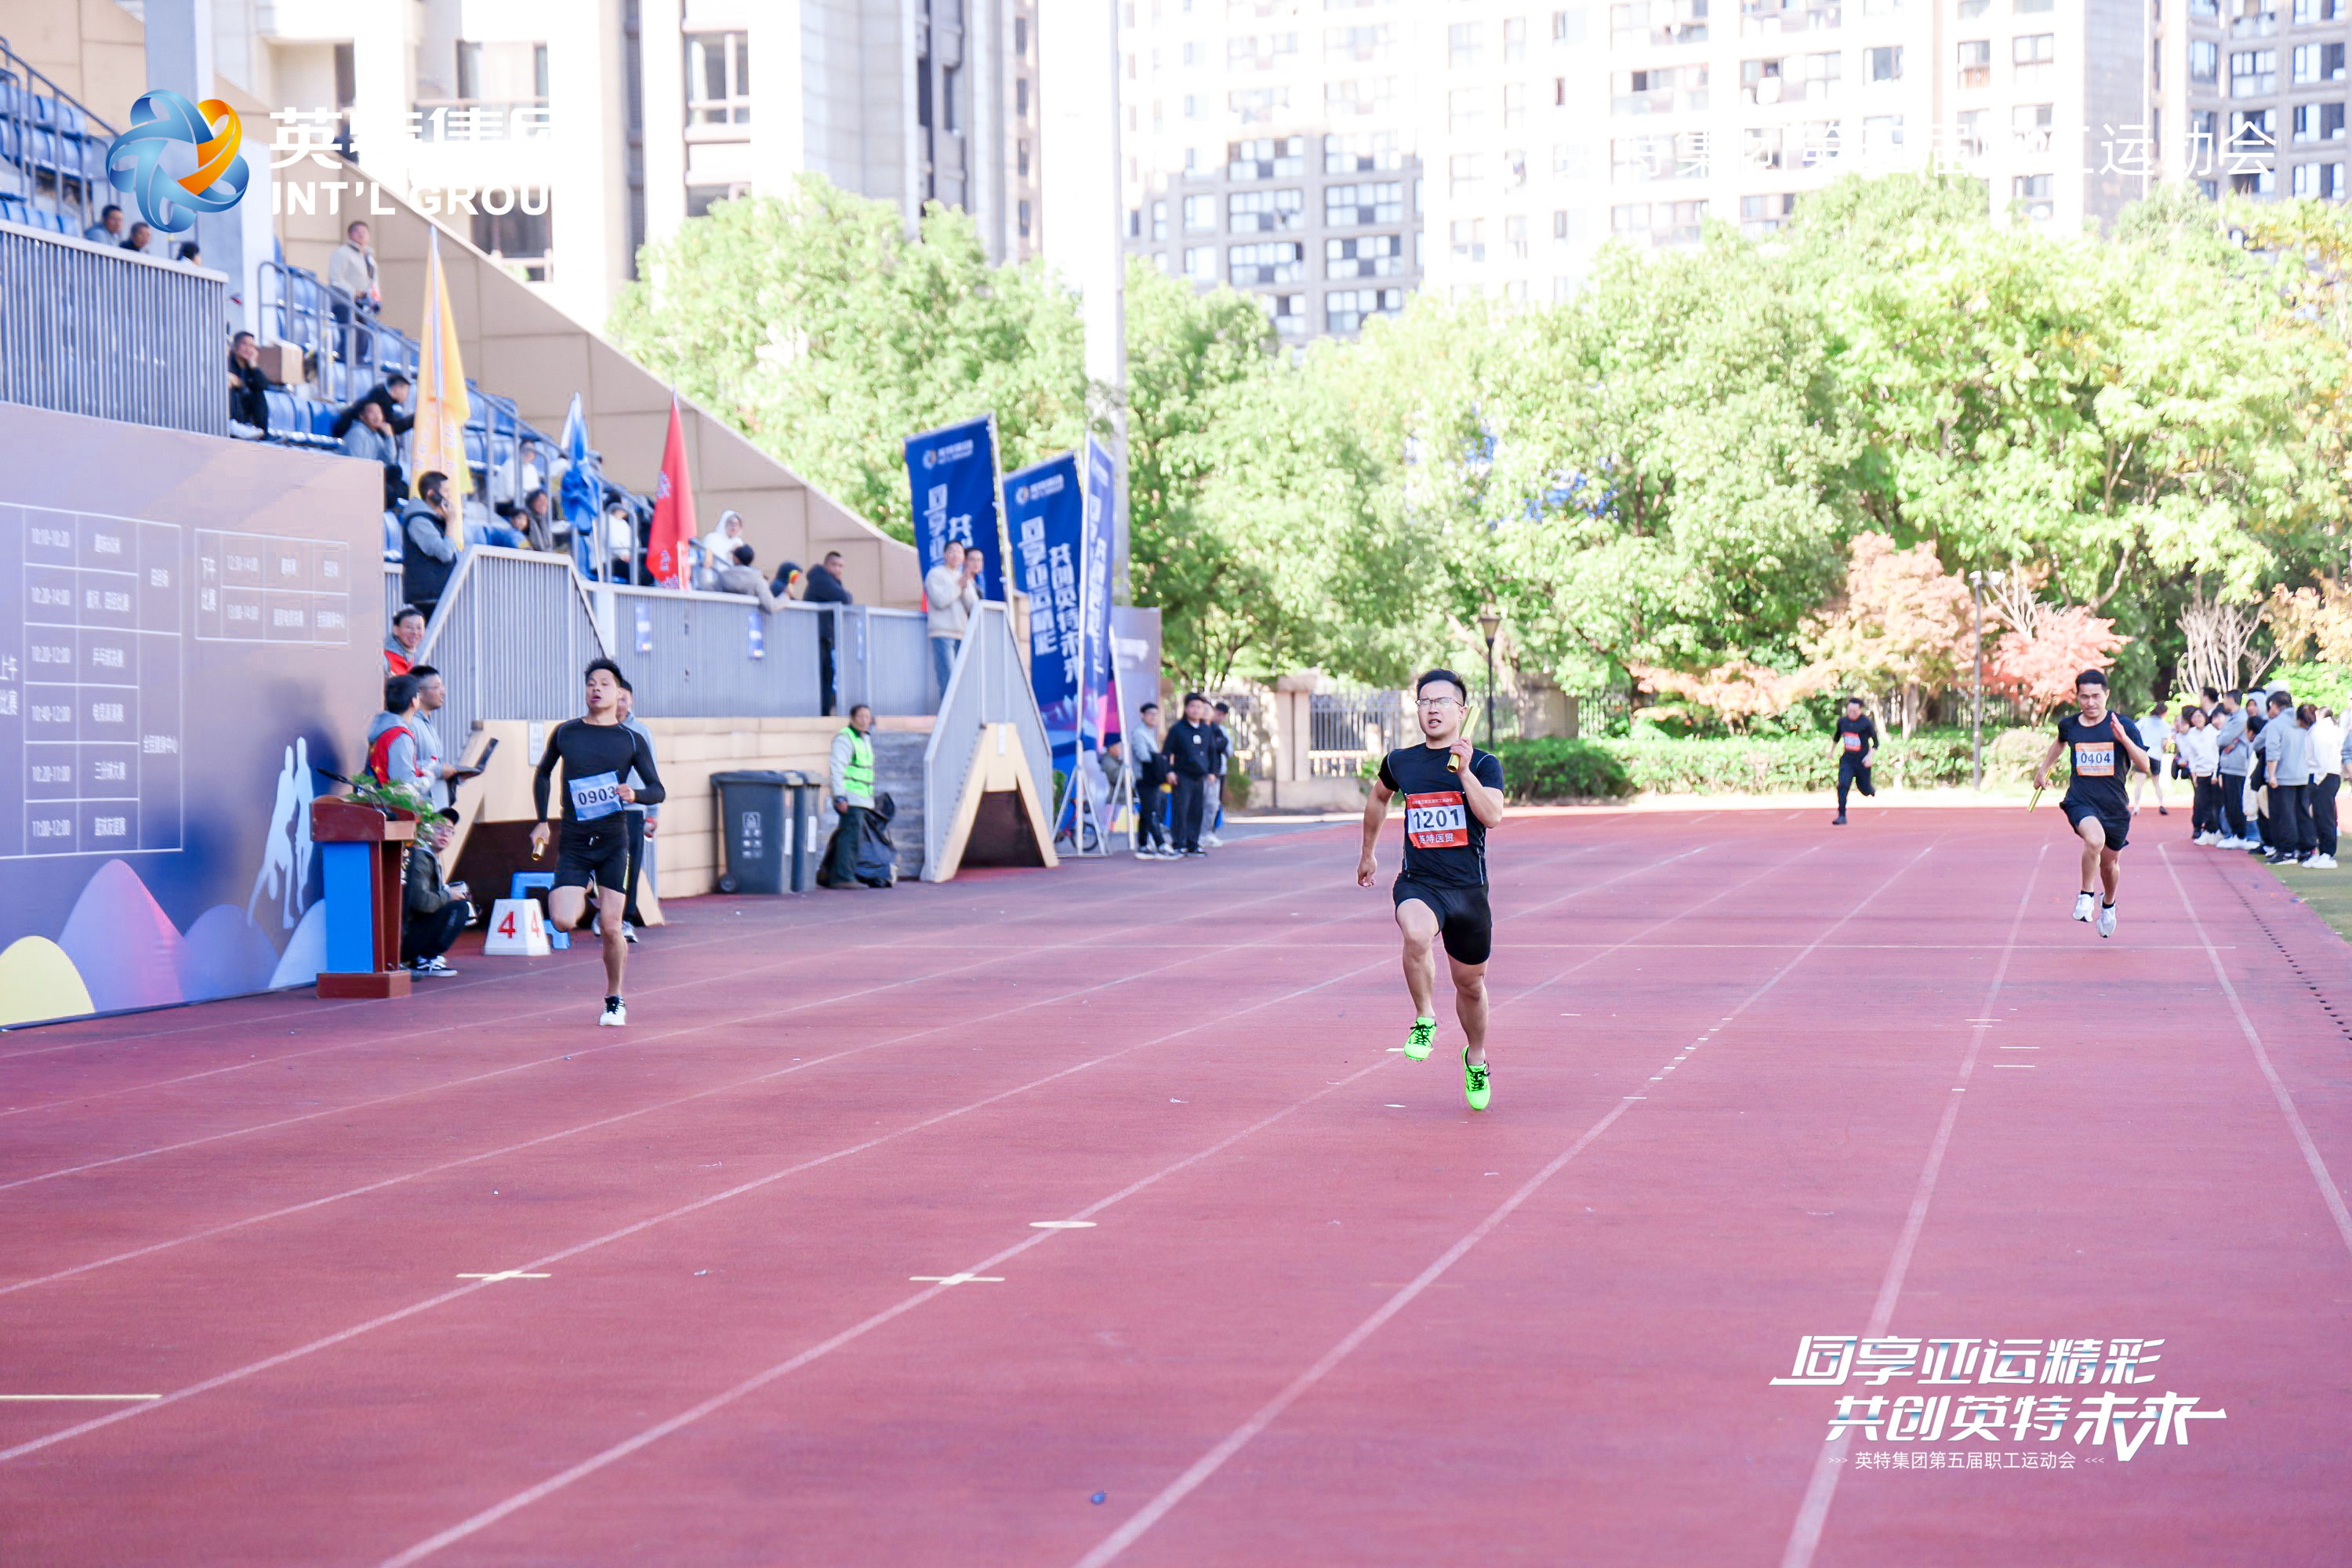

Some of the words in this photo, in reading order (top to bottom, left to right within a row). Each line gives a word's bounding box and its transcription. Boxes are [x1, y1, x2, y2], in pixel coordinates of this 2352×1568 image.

[923, 483, 947, 568] 同享亚
[0, 653, 18, 681] 上午
[2081, 753, 2111, 764] 0404
[578, 786, 615, 805] 0903
[1413, 808, 1460, 829] 1201
[497, 910, 517, 938] 4
[531, 909, 541, 938] 4
